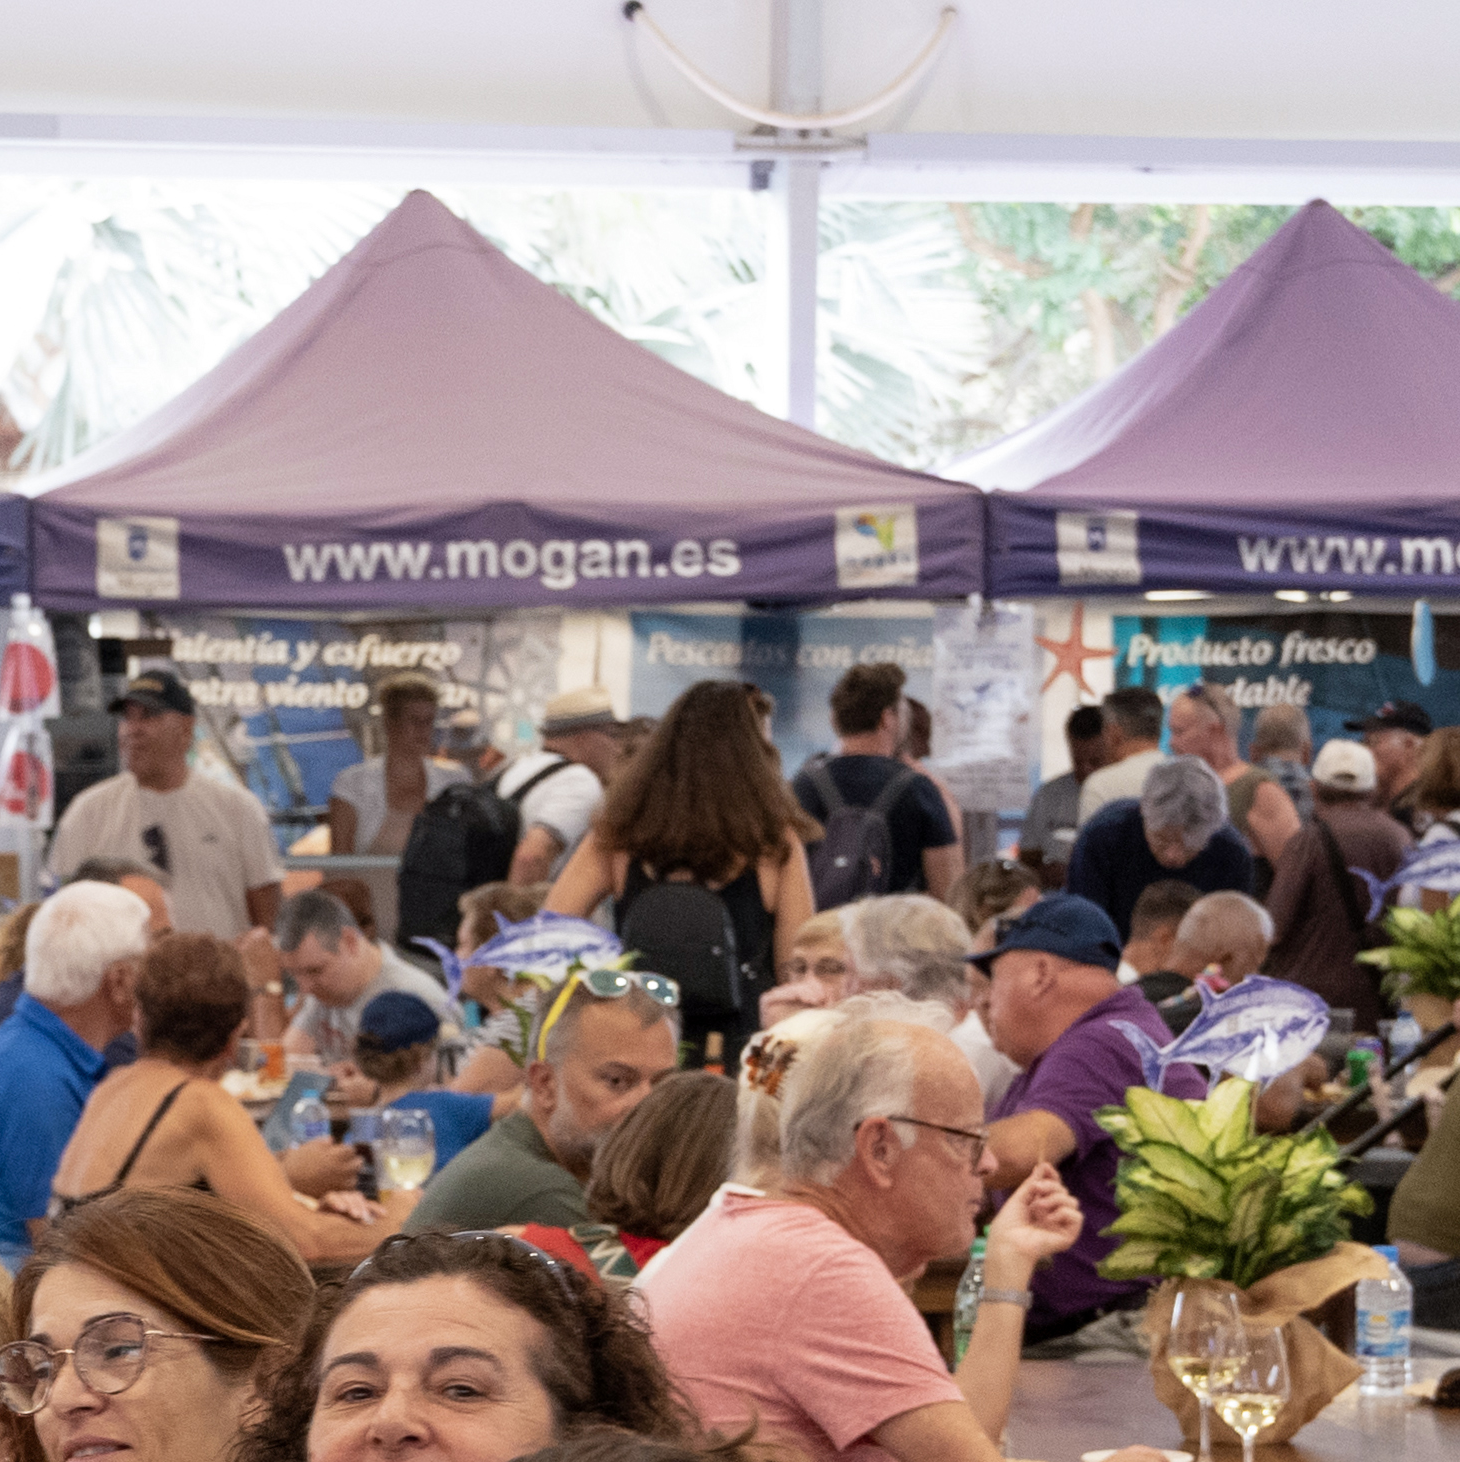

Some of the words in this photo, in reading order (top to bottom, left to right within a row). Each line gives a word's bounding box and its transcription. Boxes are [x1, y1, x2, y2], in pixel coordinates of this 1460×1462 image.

[282, 538, 742, 590] www.mogan.es
[1236, 535, 1460, 576] www.m
[157, 629, 290, 665] alentía
[289, 641, 320, 672] y
[321, 633, 463, 671] esfuerzo
[796, 644, 853, 668] con
[1126, 632, 1275, 668] Producto
[1278, 629, 1377, 668] fresco
[263, 673, 370, 709] viento
